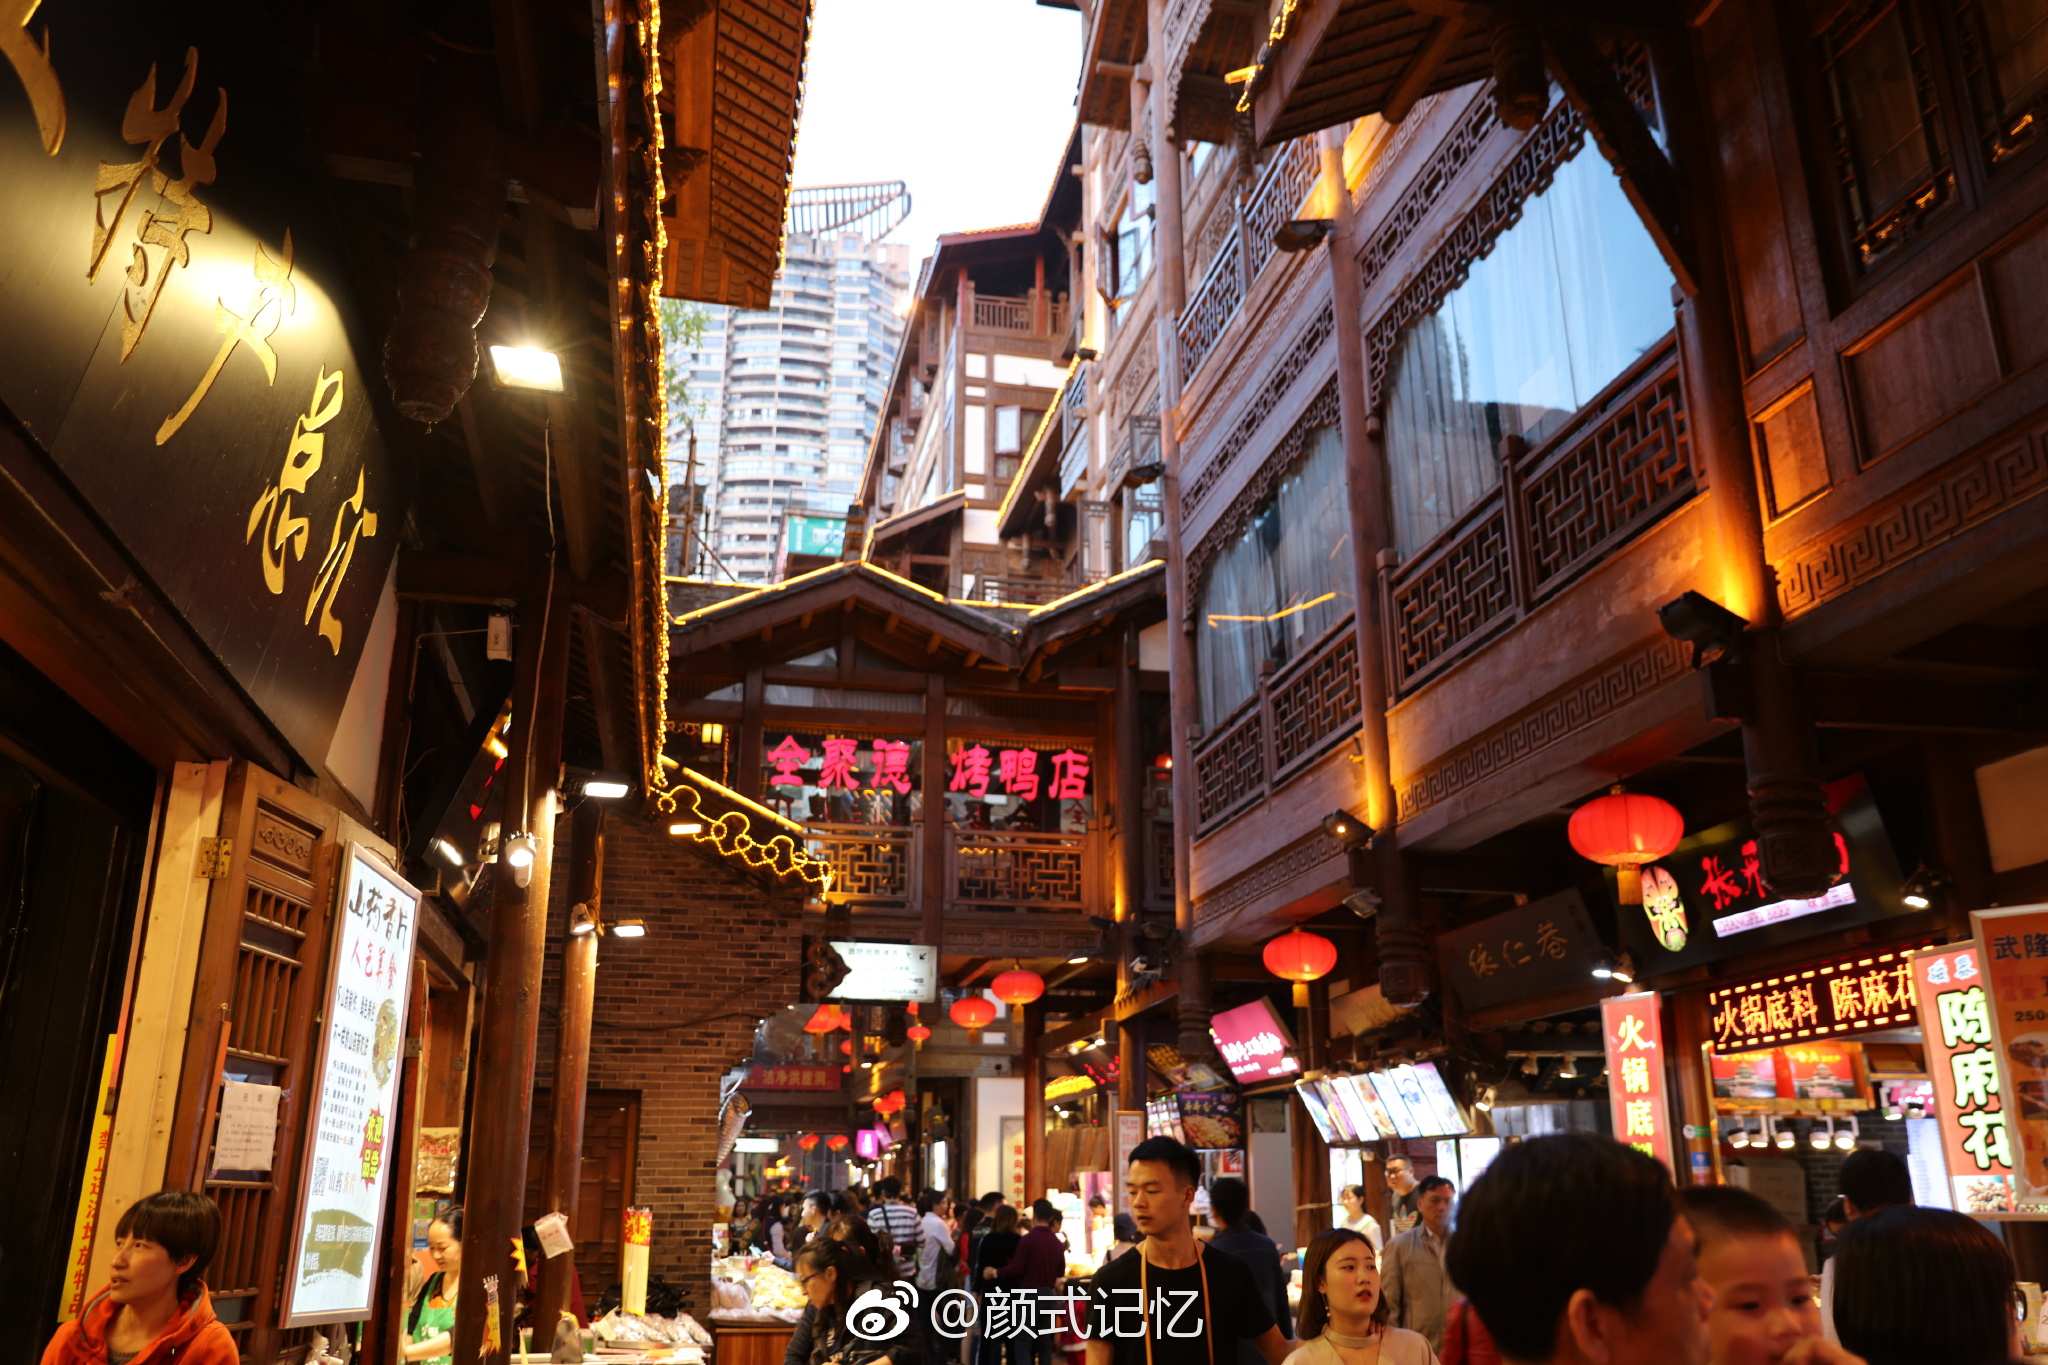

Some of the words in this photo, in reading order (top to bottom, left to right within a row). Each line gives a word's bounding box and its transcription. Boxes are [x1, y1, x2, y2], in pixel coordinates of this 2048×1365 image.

[0, 0, 377, 656] 特产总汇
[767, 734, 912, 795] 全聚德
[949, 743, 1090, 801] 烤鸭店
[349, 879, 408, 950] 山药香片
[351, 936, 397, 990] 人气美食
[1992, 932, 2048, 960] 武隆
[1713, 982, 1819, 1042] 火锅底料
[1829, 962, 1917, 1021] 陈麻花
[2014, 1009, 2048, 1022] 250
[1936, 985, 2013, 1170] 陈麻花
[365, 1112, 384, 1145] 欢迎
[328, 1169, 357, 1196] 山药香片
[361, 1148, 380, 1180] 品尝
